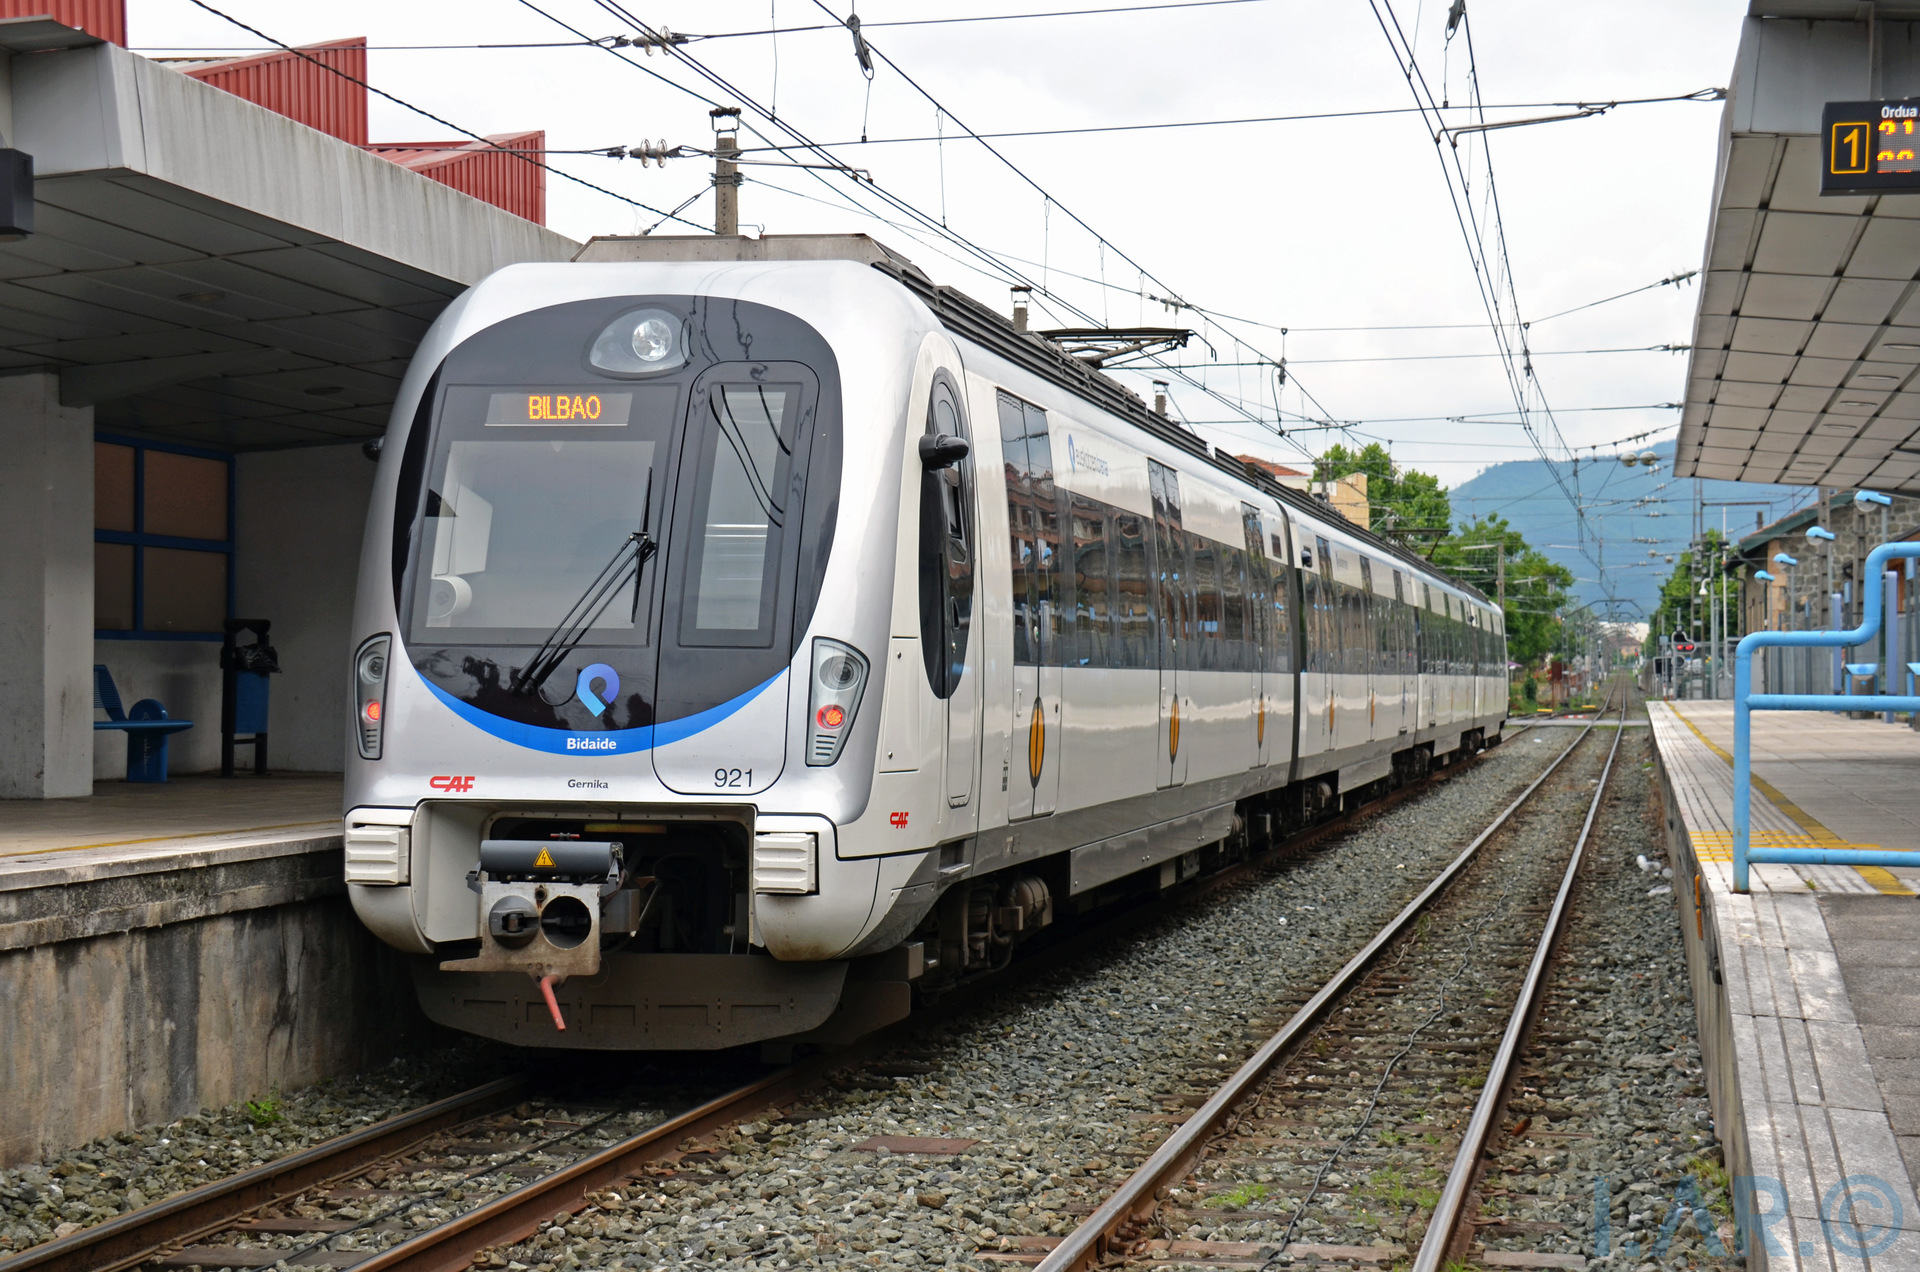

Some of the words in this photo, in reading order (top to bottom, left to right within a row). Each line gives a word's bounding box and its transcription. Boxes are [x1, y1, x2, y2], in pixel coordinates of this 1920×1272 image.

[1881, 105, 1918, 119] Ordua
[1843, 128, 1859, 168] 1
[528, 395, 601, 420] BILBAO
[566, 737, 617, 750] Bidaide
[429, 775, 476, 793] CAF
[567, 778, 609, 790] Gernika
[714, 768, 754, 788] 921
[889, 811, 909, 829] CAF
